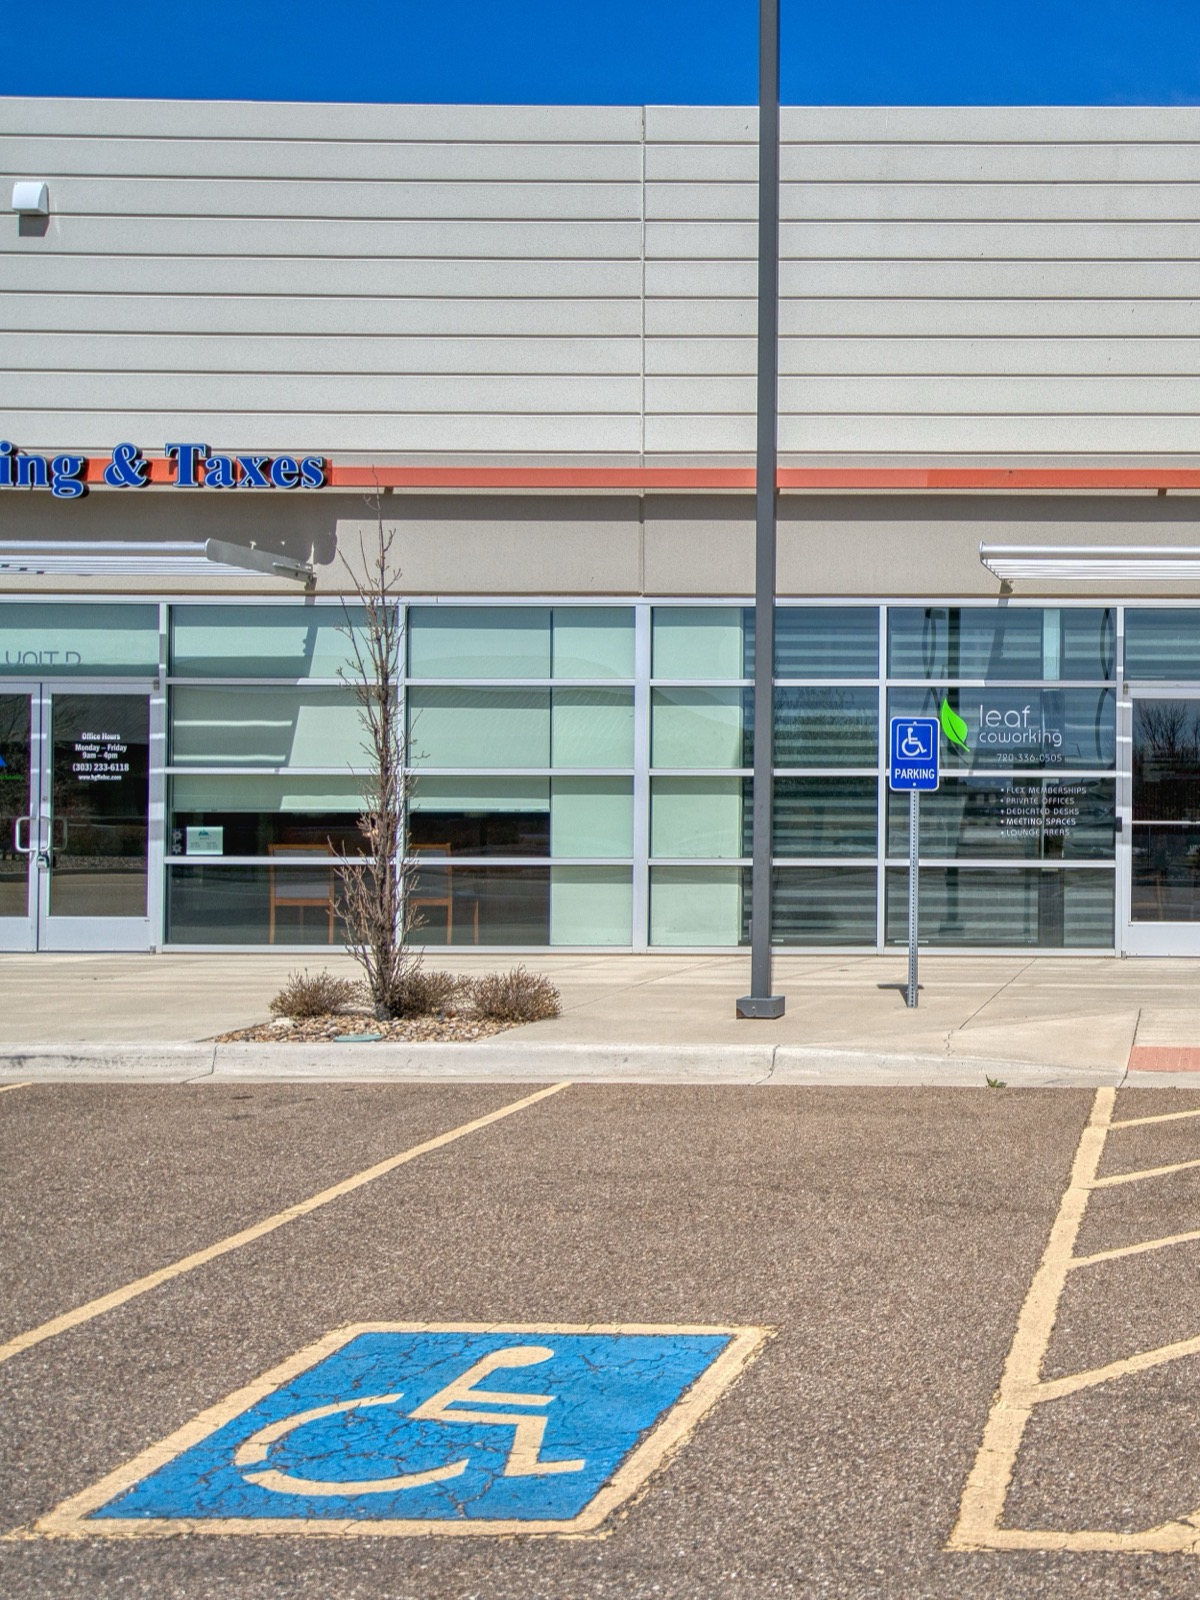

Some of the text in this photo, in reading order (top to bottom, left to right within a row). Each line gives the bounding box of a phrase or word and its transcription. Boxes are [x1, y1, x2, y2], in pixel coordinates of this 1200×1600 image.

[104, 442, 148, 488] &
[165, 442, 326, 488] Taxes
[5, 651, 60, 667] UNIT
[980, 704, 1031, 728] leaf
[81, 732, 120, 740] Office Hours
[979, 728, 1063, 748] coworking
[75, 744, 100, 753] Monday
[107, 744, 127, 753] Friday
[103, 752, 118, 760] 4pm
[72, 763, 130, 772] (303) 233-6118
[894, 768, 935, 780] PARKING
[1006, 786, 1087, 795] FLEX MEMBERSHIPS
[1006, 797, 1075, 805] PRIVATE OFFICES
[1006, 808, 1080, 816] DEDICATED DESKS
[1006, 817, 1077, 826] MEETING SPACES
[1006, 828, 1070, 837] LOUNGE AREAS
